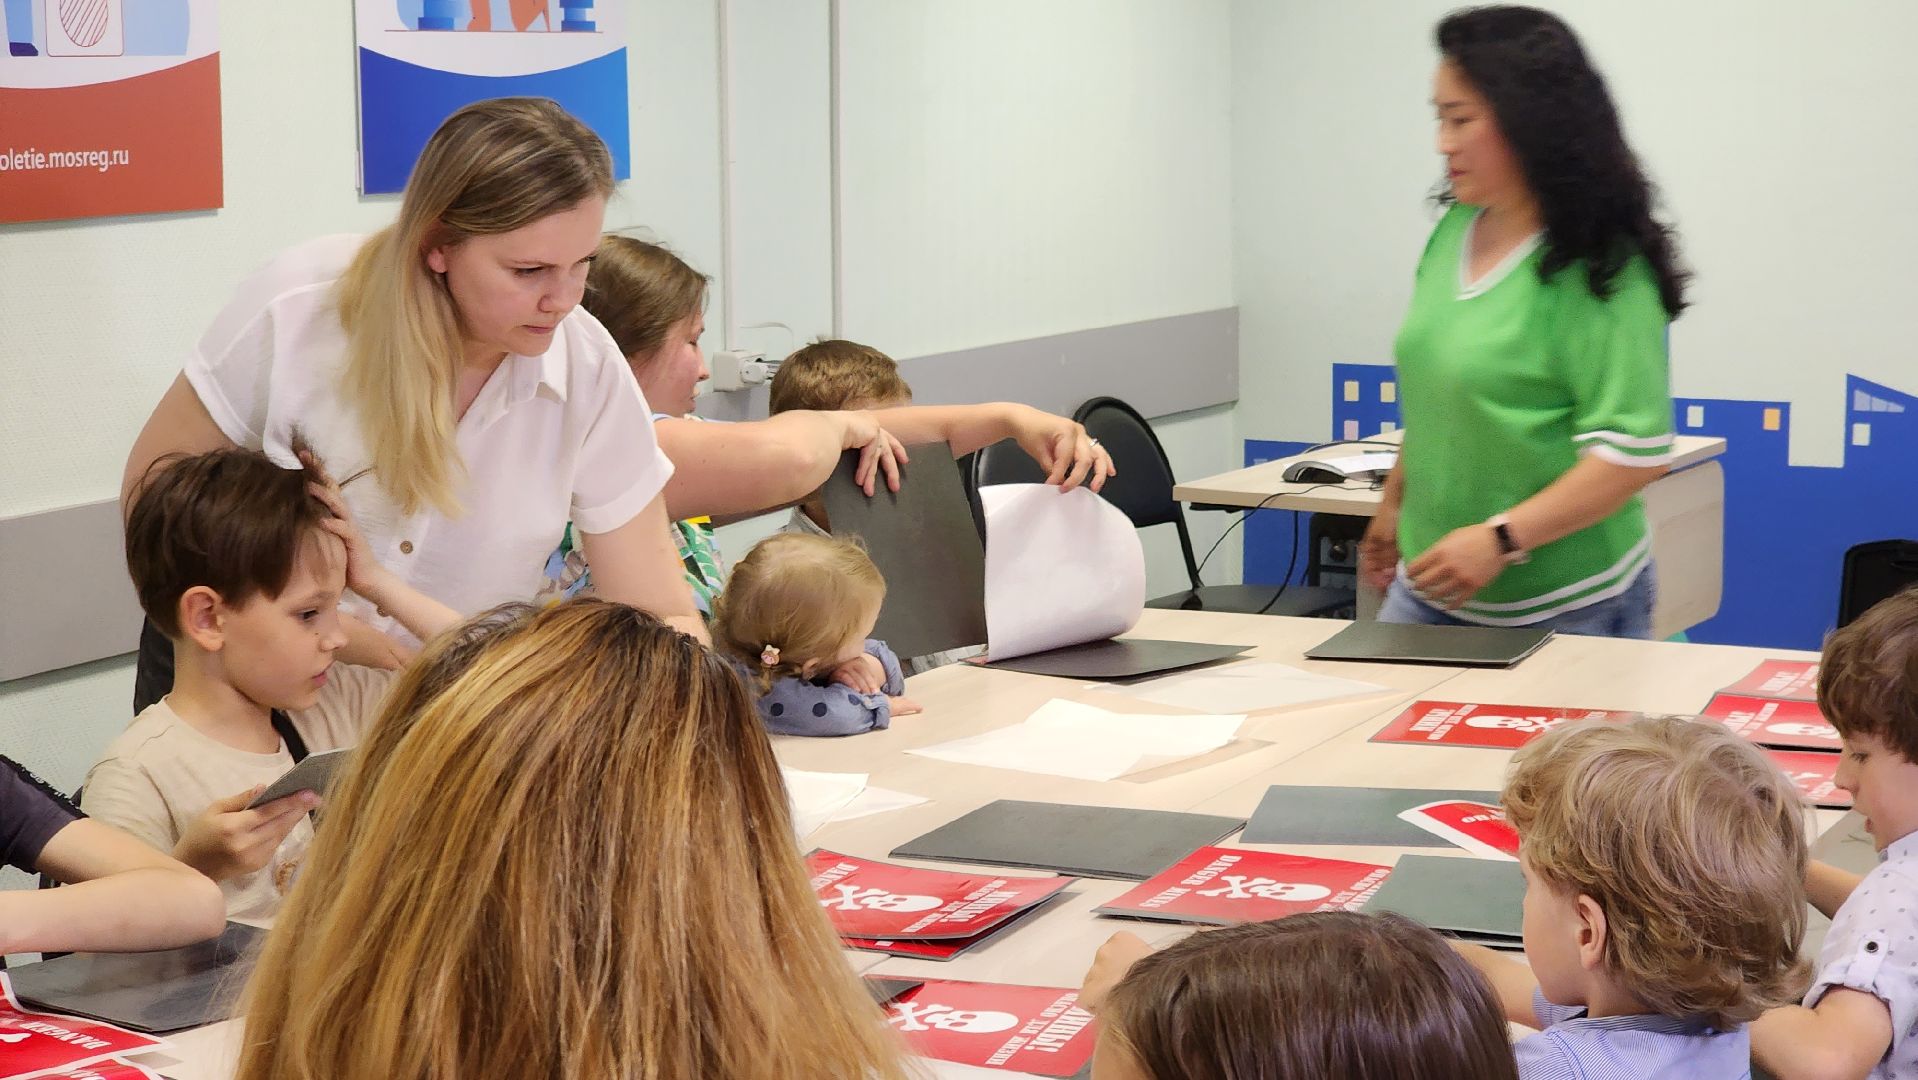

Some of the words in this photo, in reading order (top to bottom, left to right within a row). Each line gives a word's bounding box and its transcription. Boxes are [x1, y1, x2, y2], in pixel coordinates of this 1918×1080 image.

[0, 147, 129, 172] oletie.mosreg.ru
[1181, 854, 1244, 886] DANGER
[1139, 886, 1191, 908] MINES
[985, 1036, 1031, 1066] ЖИЗНИ
